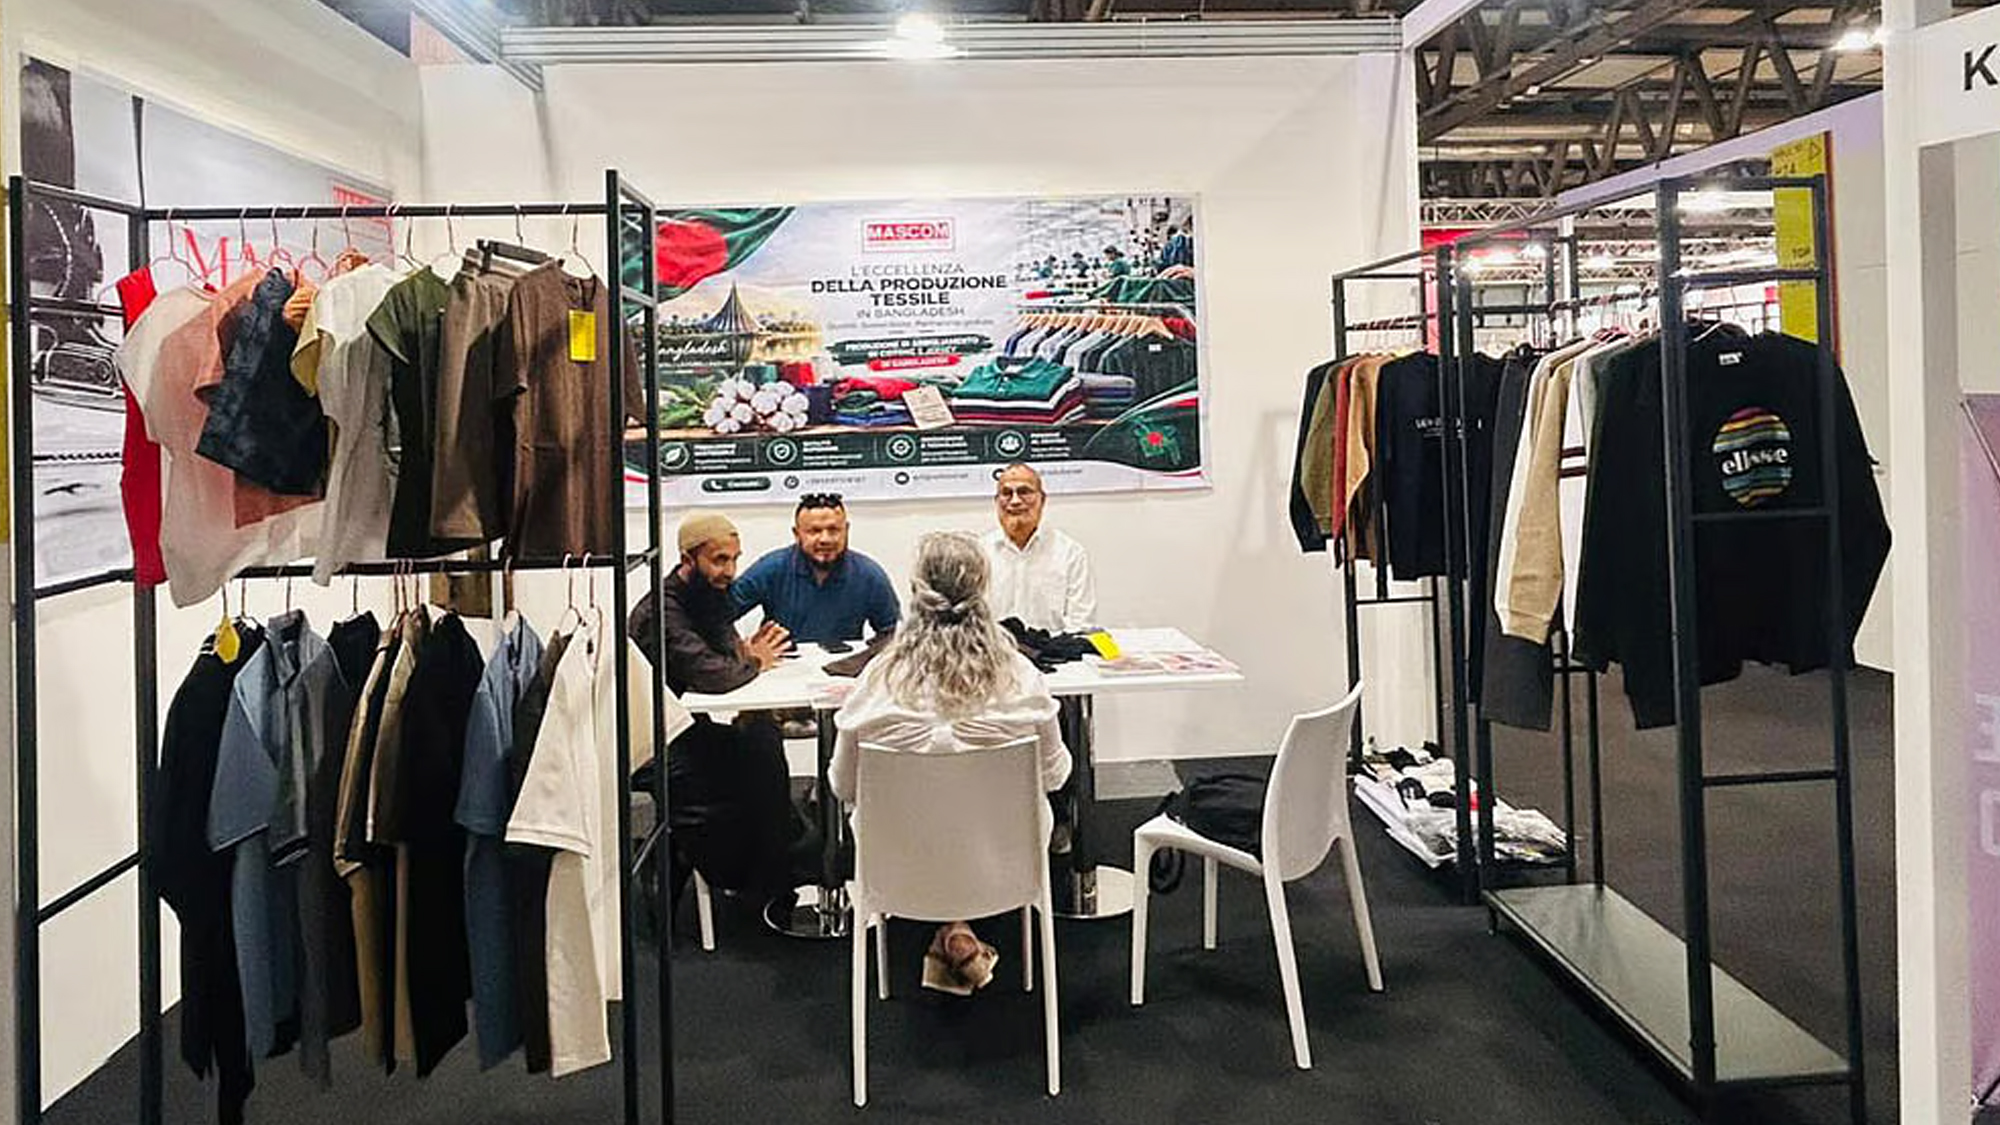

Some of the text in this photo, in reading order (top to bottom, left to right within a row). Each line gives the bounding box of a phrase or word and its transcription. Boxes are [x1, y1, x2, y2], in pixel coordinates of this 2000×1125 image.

[867, 223, 949, 240] MASCOM
[851, 263, 965, 278] L'ECCELLENZA
[811, 275, 1008, 293] DELLA PRODUZIONE
[870, 291, 950, 307] TESSILE
[857, 307, 965, 319] IN BANGLADESH
[641, 339, 728, 362] angladesh
